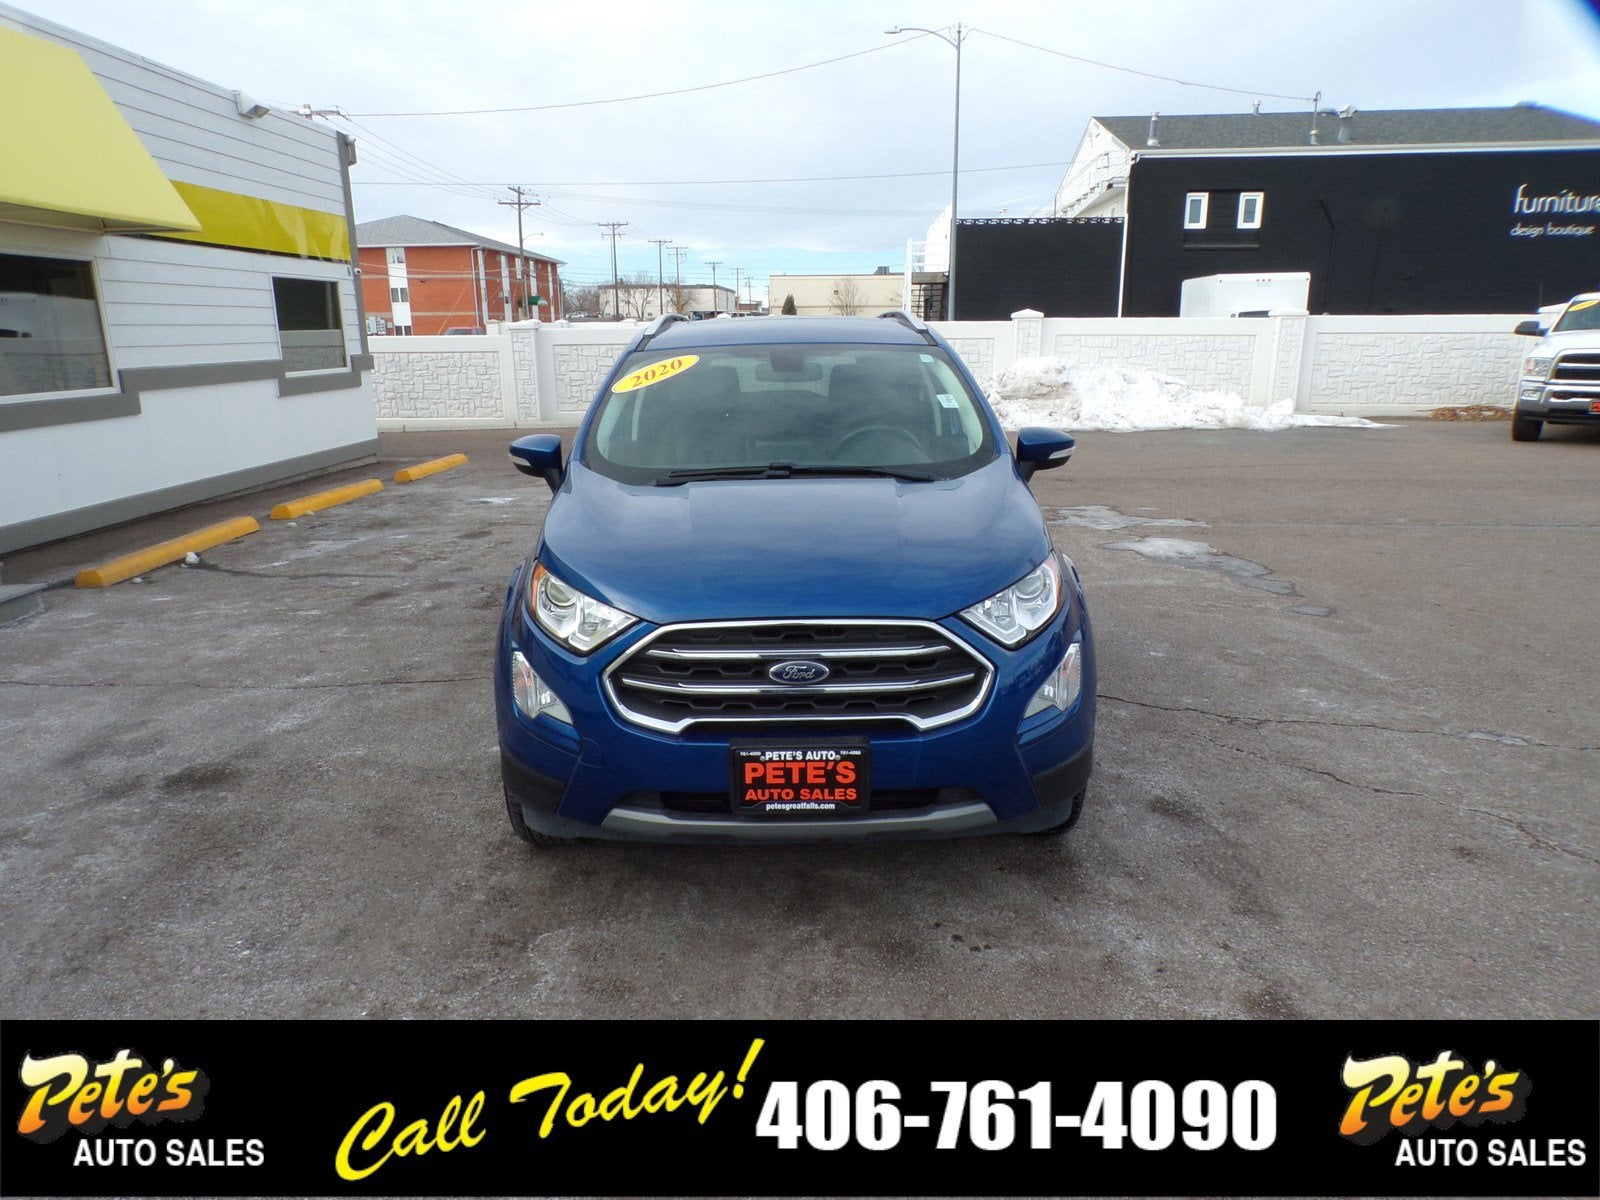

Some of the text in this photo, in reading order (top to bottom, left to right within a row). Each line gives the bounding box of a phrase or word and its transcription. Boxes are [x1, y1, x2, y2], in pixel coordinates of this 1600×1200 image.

[1510, 222, 1597, 238] design boutique
[630, 359, 683, 388] 2020
[782, 665, 816, 680] Ford
[765, 750, 836, 761] PETE'S AUTO
[744, 761, 856, 785] PETE'S
[744, 788, 857, 801] AUTO SALES
[765, 801, 836, 812] petesgreatfalls.com
